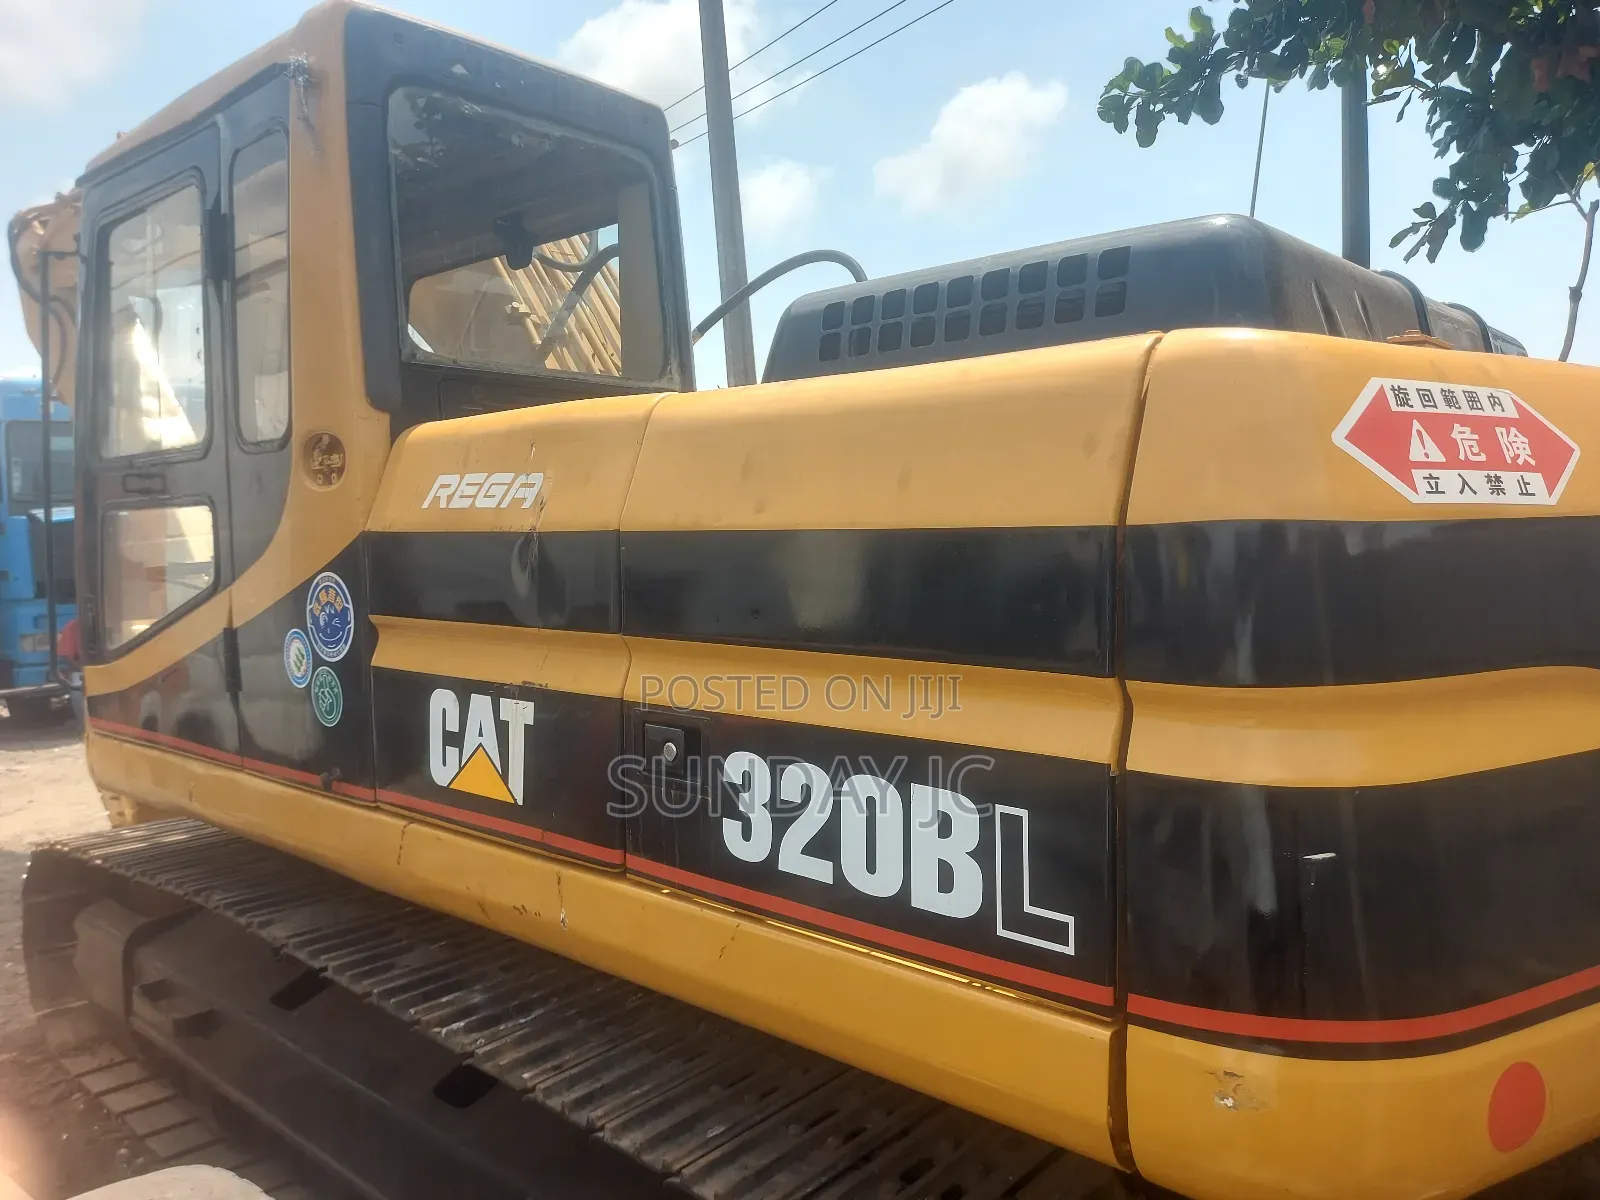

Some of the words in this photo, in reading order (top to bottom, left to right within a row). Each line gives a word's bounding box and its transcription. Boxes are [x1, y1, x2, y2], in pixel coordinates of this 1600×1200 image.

[1389, 384, 1506, 413] 旋回範囲内
[1450, 423, 1536, 466] 危険
[421, 472, 544, 509] REGA
[1422, 473, 1536, 496] 立入禁止
[429, 688, 535, 806] CAT
